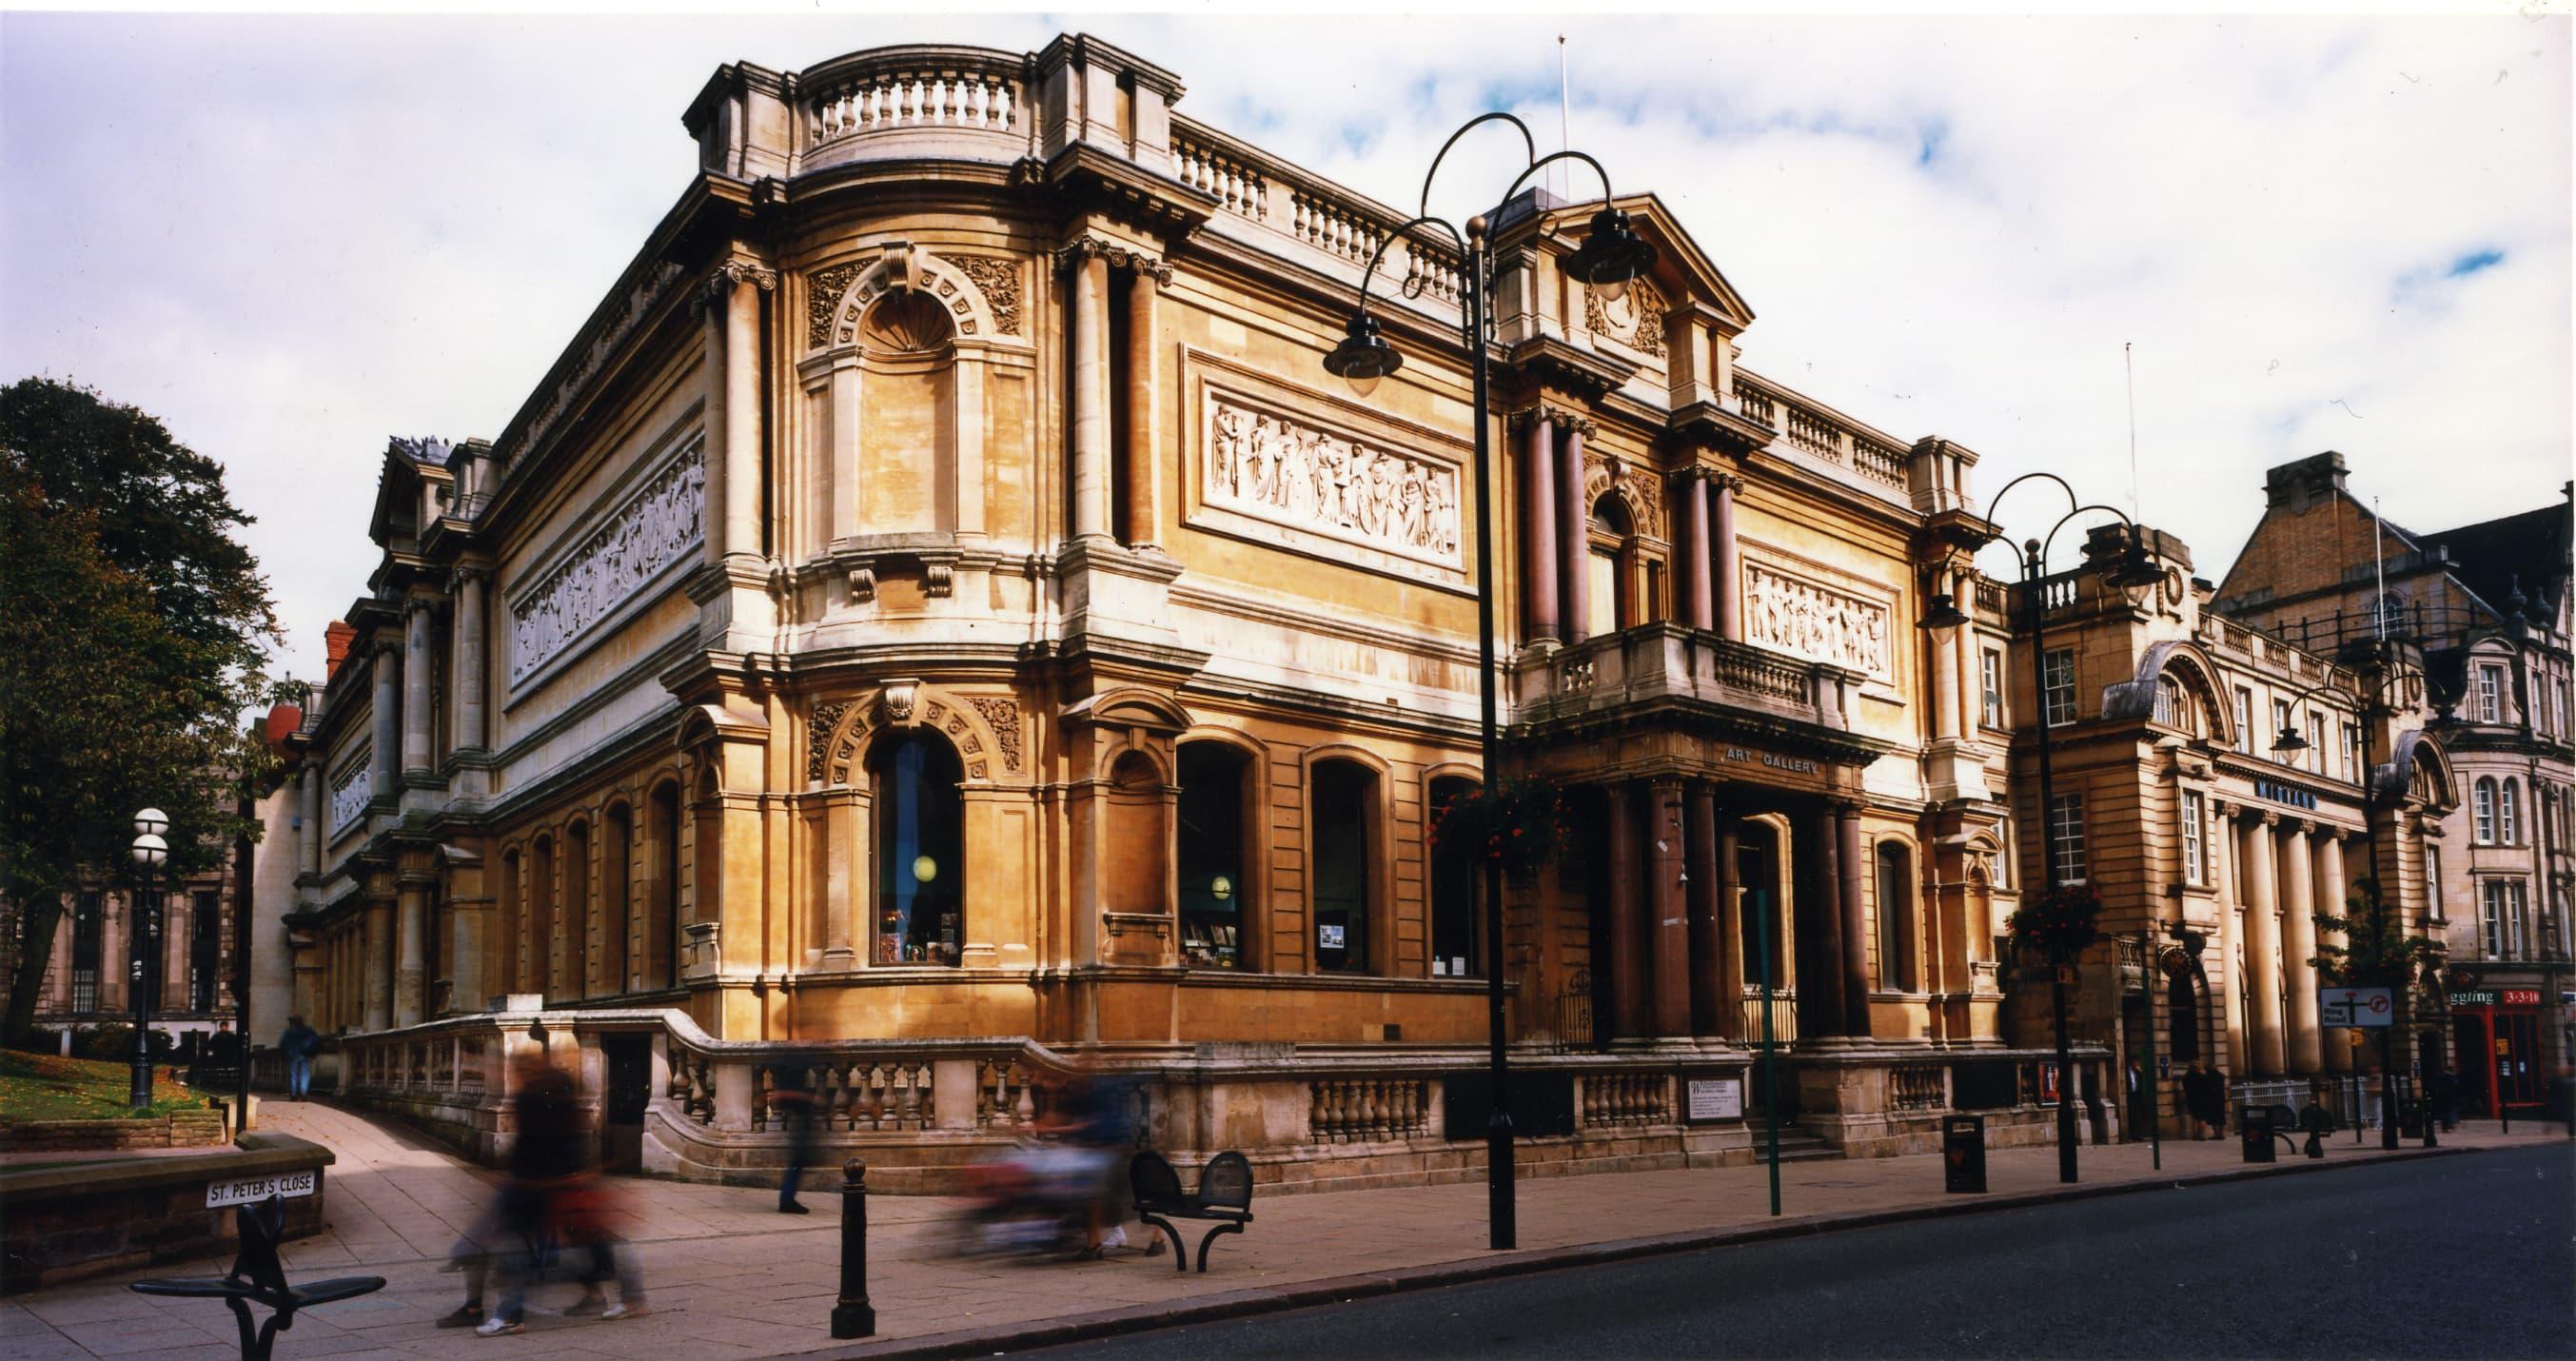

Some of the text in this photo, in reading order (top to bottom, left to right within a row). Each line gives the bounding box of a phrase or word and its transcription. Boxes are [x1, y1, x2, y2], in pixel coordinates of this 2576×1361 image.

[1726, 747, 1819, 776] ART GALLERY
[2450, 990, 2494, 1006] ggling
[2324, 1007, 2344, 1016] Ring
[2324, 1016, 2346, 1024] Road
[210, 1174, 311, 1201] ST. PETER'S CLOSE
